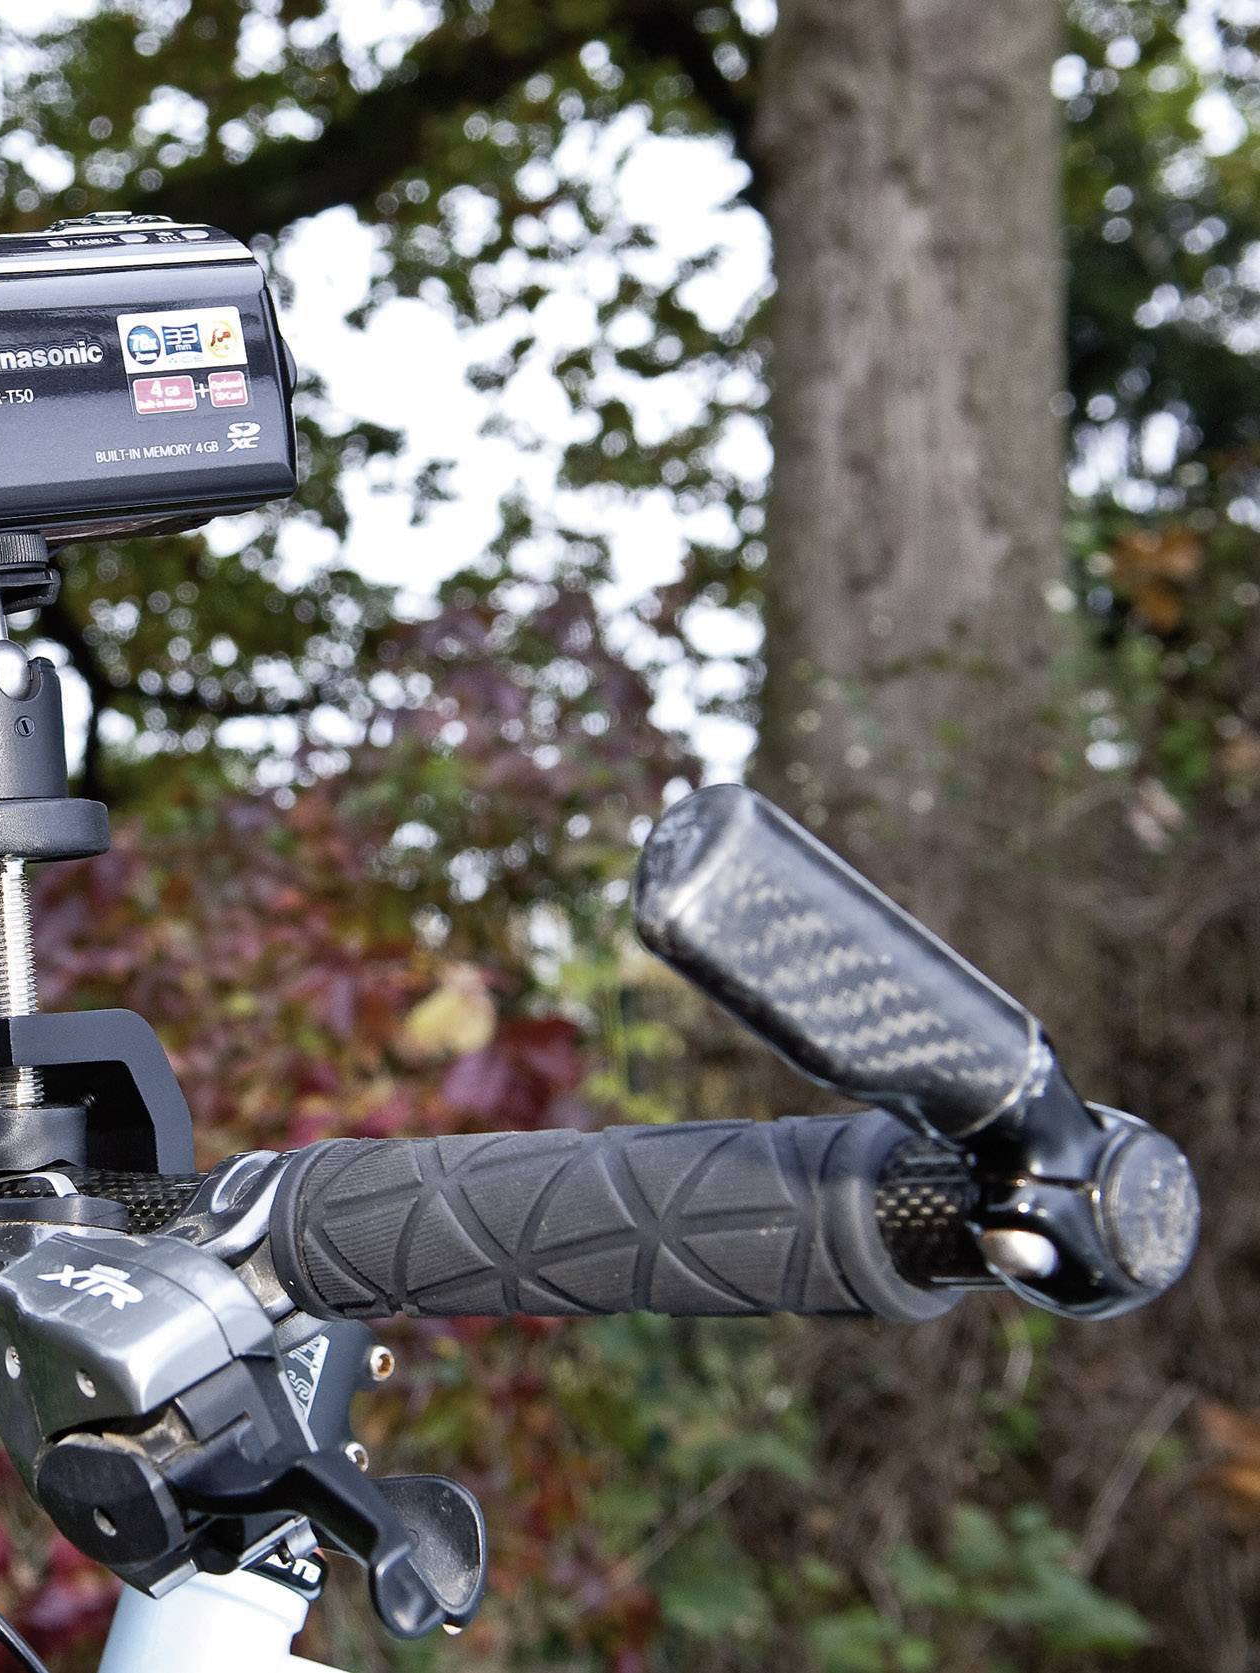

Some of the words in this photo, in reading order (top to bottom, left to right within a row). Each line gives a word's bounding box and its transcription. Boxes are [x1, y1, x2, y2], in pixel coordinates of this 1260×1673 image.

[164, 328, 199, 346] 33
[151, 381, 164, 398] 4
[95, 448, 141, 463] BUILT-IN
[143, 443, 192, 459] MEMORY
[36, 1264, 144, 1311] XTR
